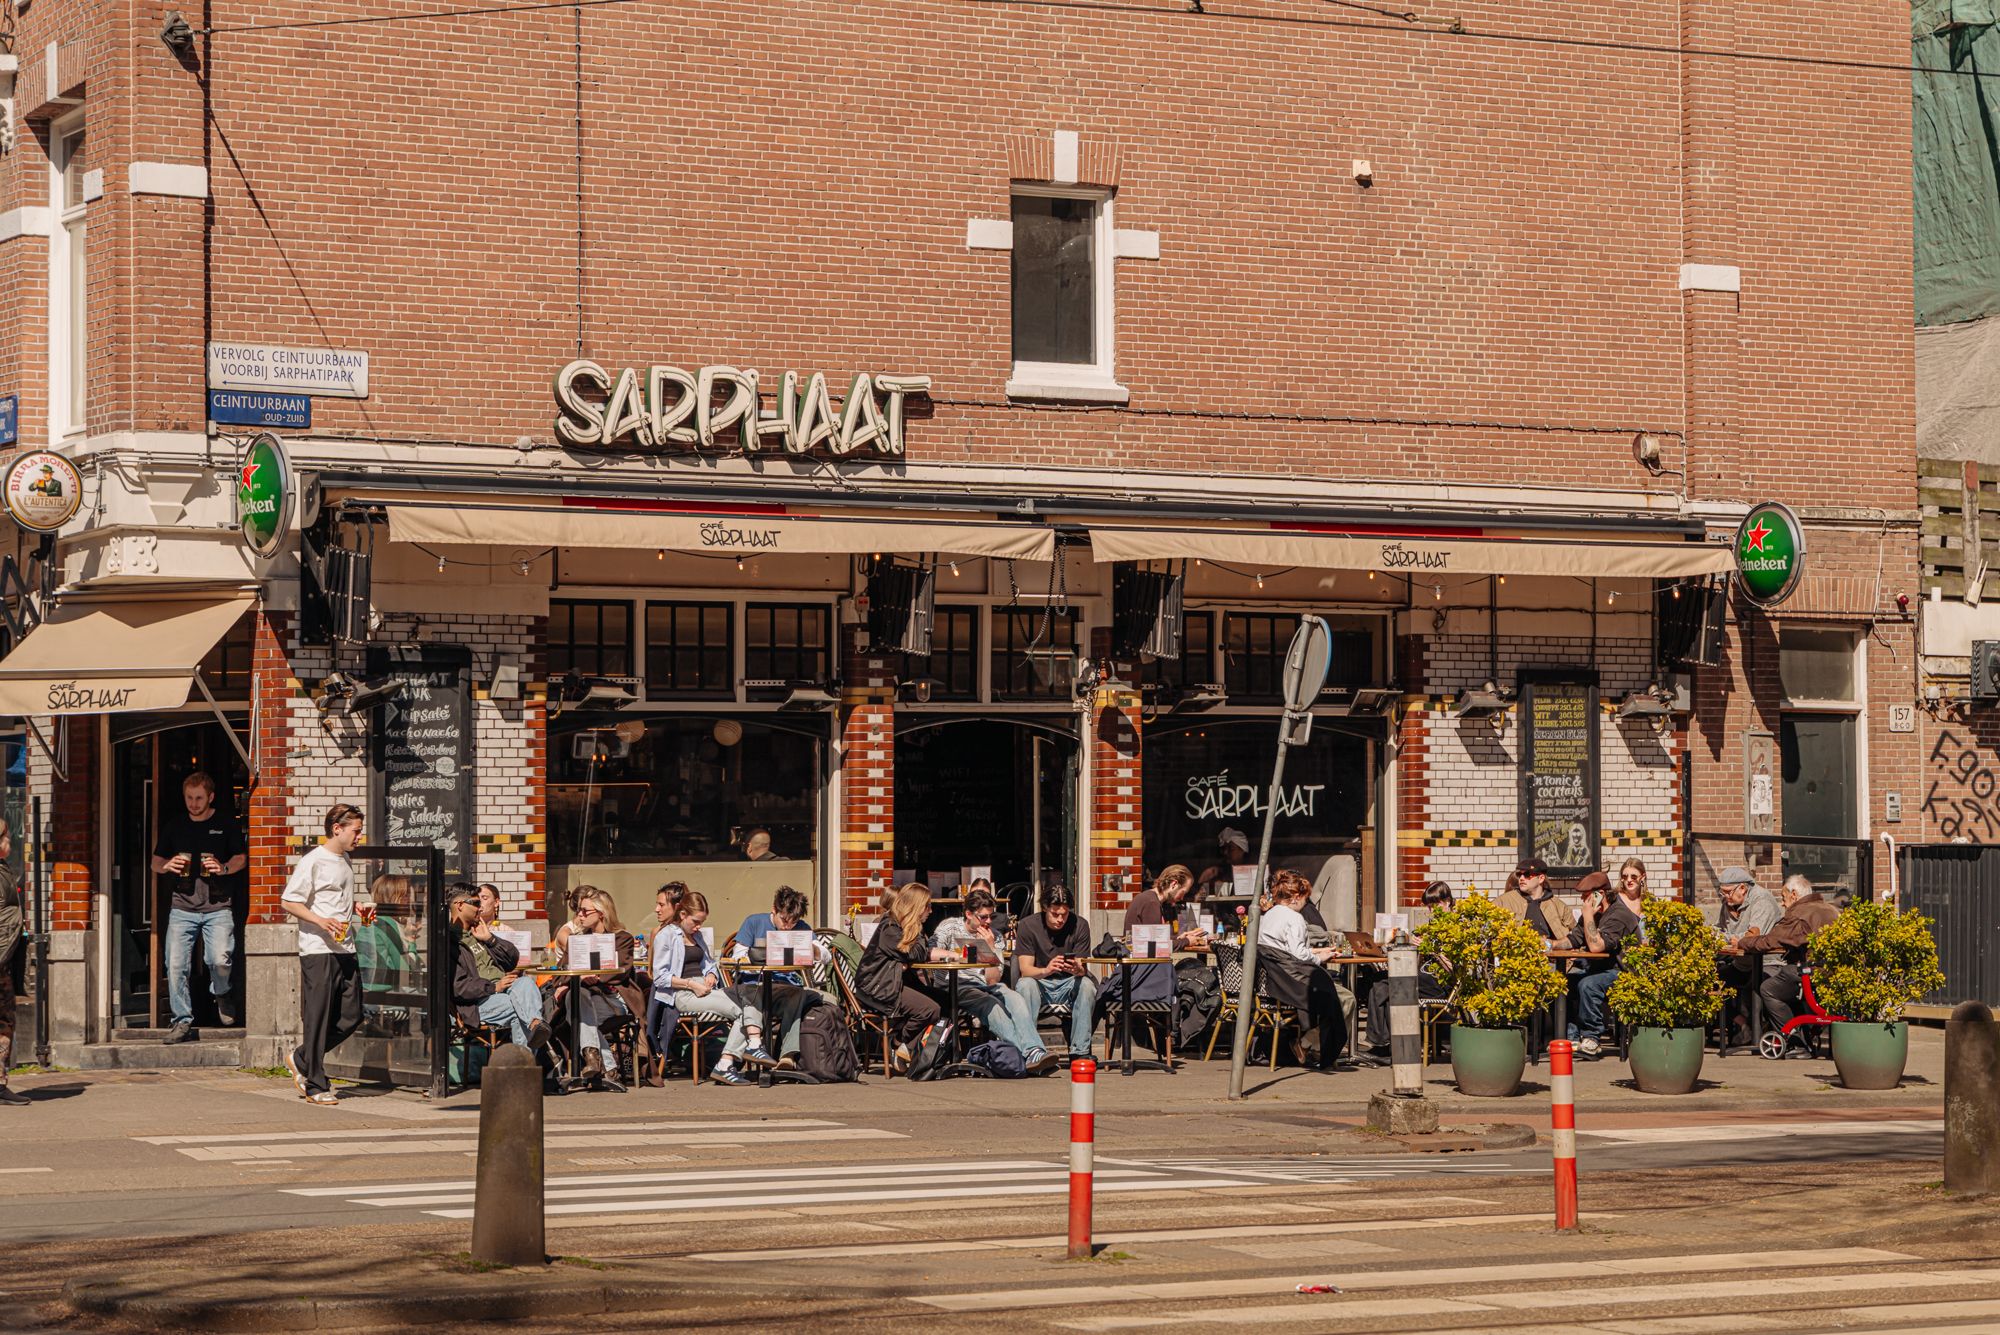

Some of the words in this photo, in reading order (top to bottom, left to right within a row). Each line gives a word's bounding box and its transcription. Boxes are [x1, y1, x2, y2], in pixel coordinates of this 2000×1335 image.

[213, 347, 265, 362] VERVOLG
[272, 351, 362, 367] CEINTUURBAAN
[221, 363, 268, 381] VOORBIJ
[273, 366, 355, 382] SARPHATIPARK
[213, 394, 305, 412] CEINTUURBAAN
[553, 359, 932, 455] SARPHAAT
[264, 412, 305, 423] OUD-ZUID
[11, 458, 38, 492] BIRRA
[39, 456, 78, 494] MORETTI
[700, 520, 724, 529] CAFÉ
[700, 528, 782, 548] SARPHAAT
[1382, 542, 1402, 551] CAFÉ
[1382, 550, 1451, 568] SARPHAAT
[1740, 556, 1787, 571] eineken
[49, 680, 77, 691] CAFÉ
[47, 688, 137, 710] SARPHAAT
[1894, 707, 1910, 720] 157
[1187, 768, 1229, 787] CAFÉ
[1184, 784, 1325, 819] SARPHAAT
